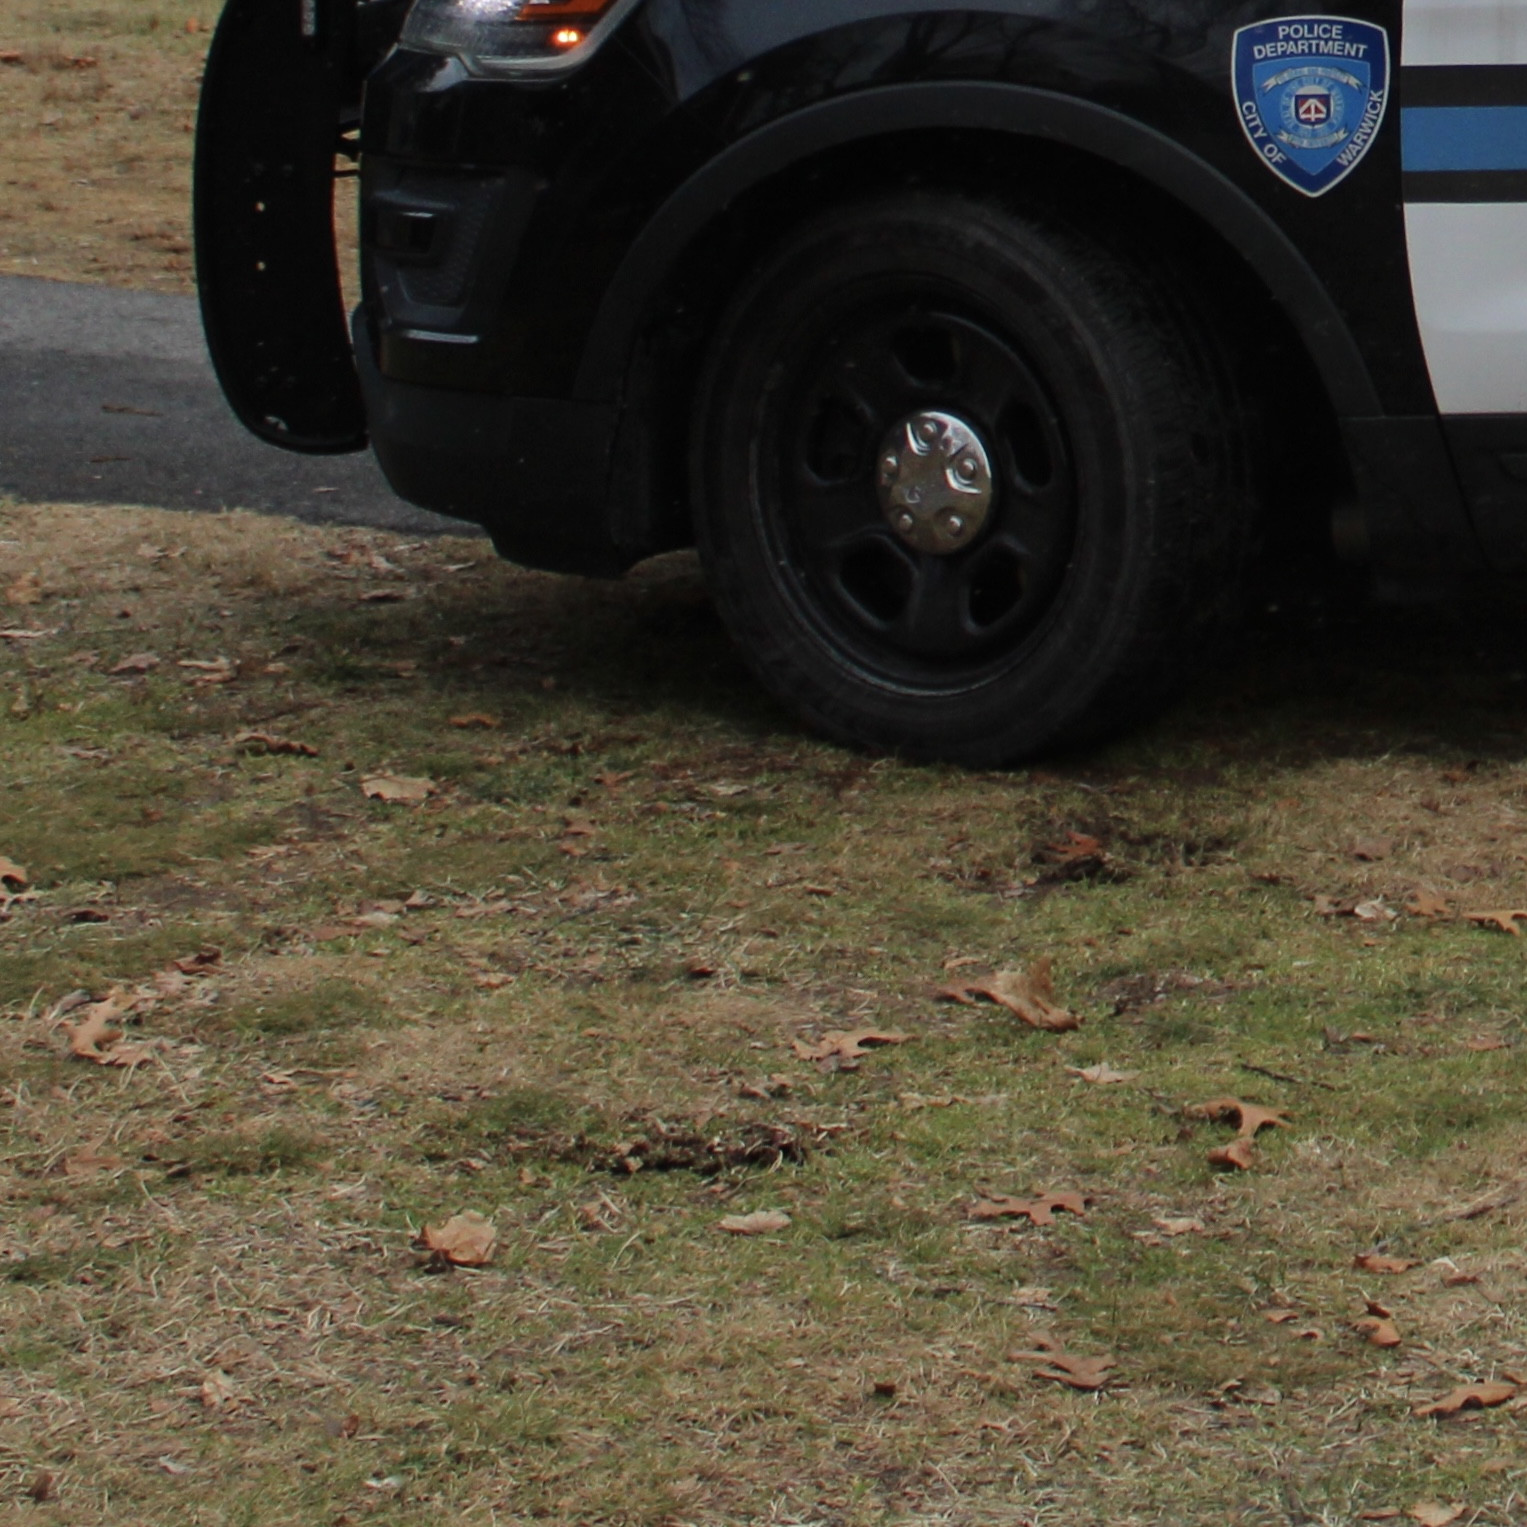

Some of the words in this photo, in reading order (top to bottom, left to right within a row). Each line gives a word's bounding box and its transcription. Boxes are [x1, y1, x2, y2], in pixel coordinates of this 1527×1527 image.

[1277, 24, 1344, 40] POLICE
[1253, 40, 1368, 60] DEPARTMENT
[1242, 101, 1268, 139] CITY
[1263, 143, 1287, 165] OF
[1336, 89, 1384, 167] WARWICK
